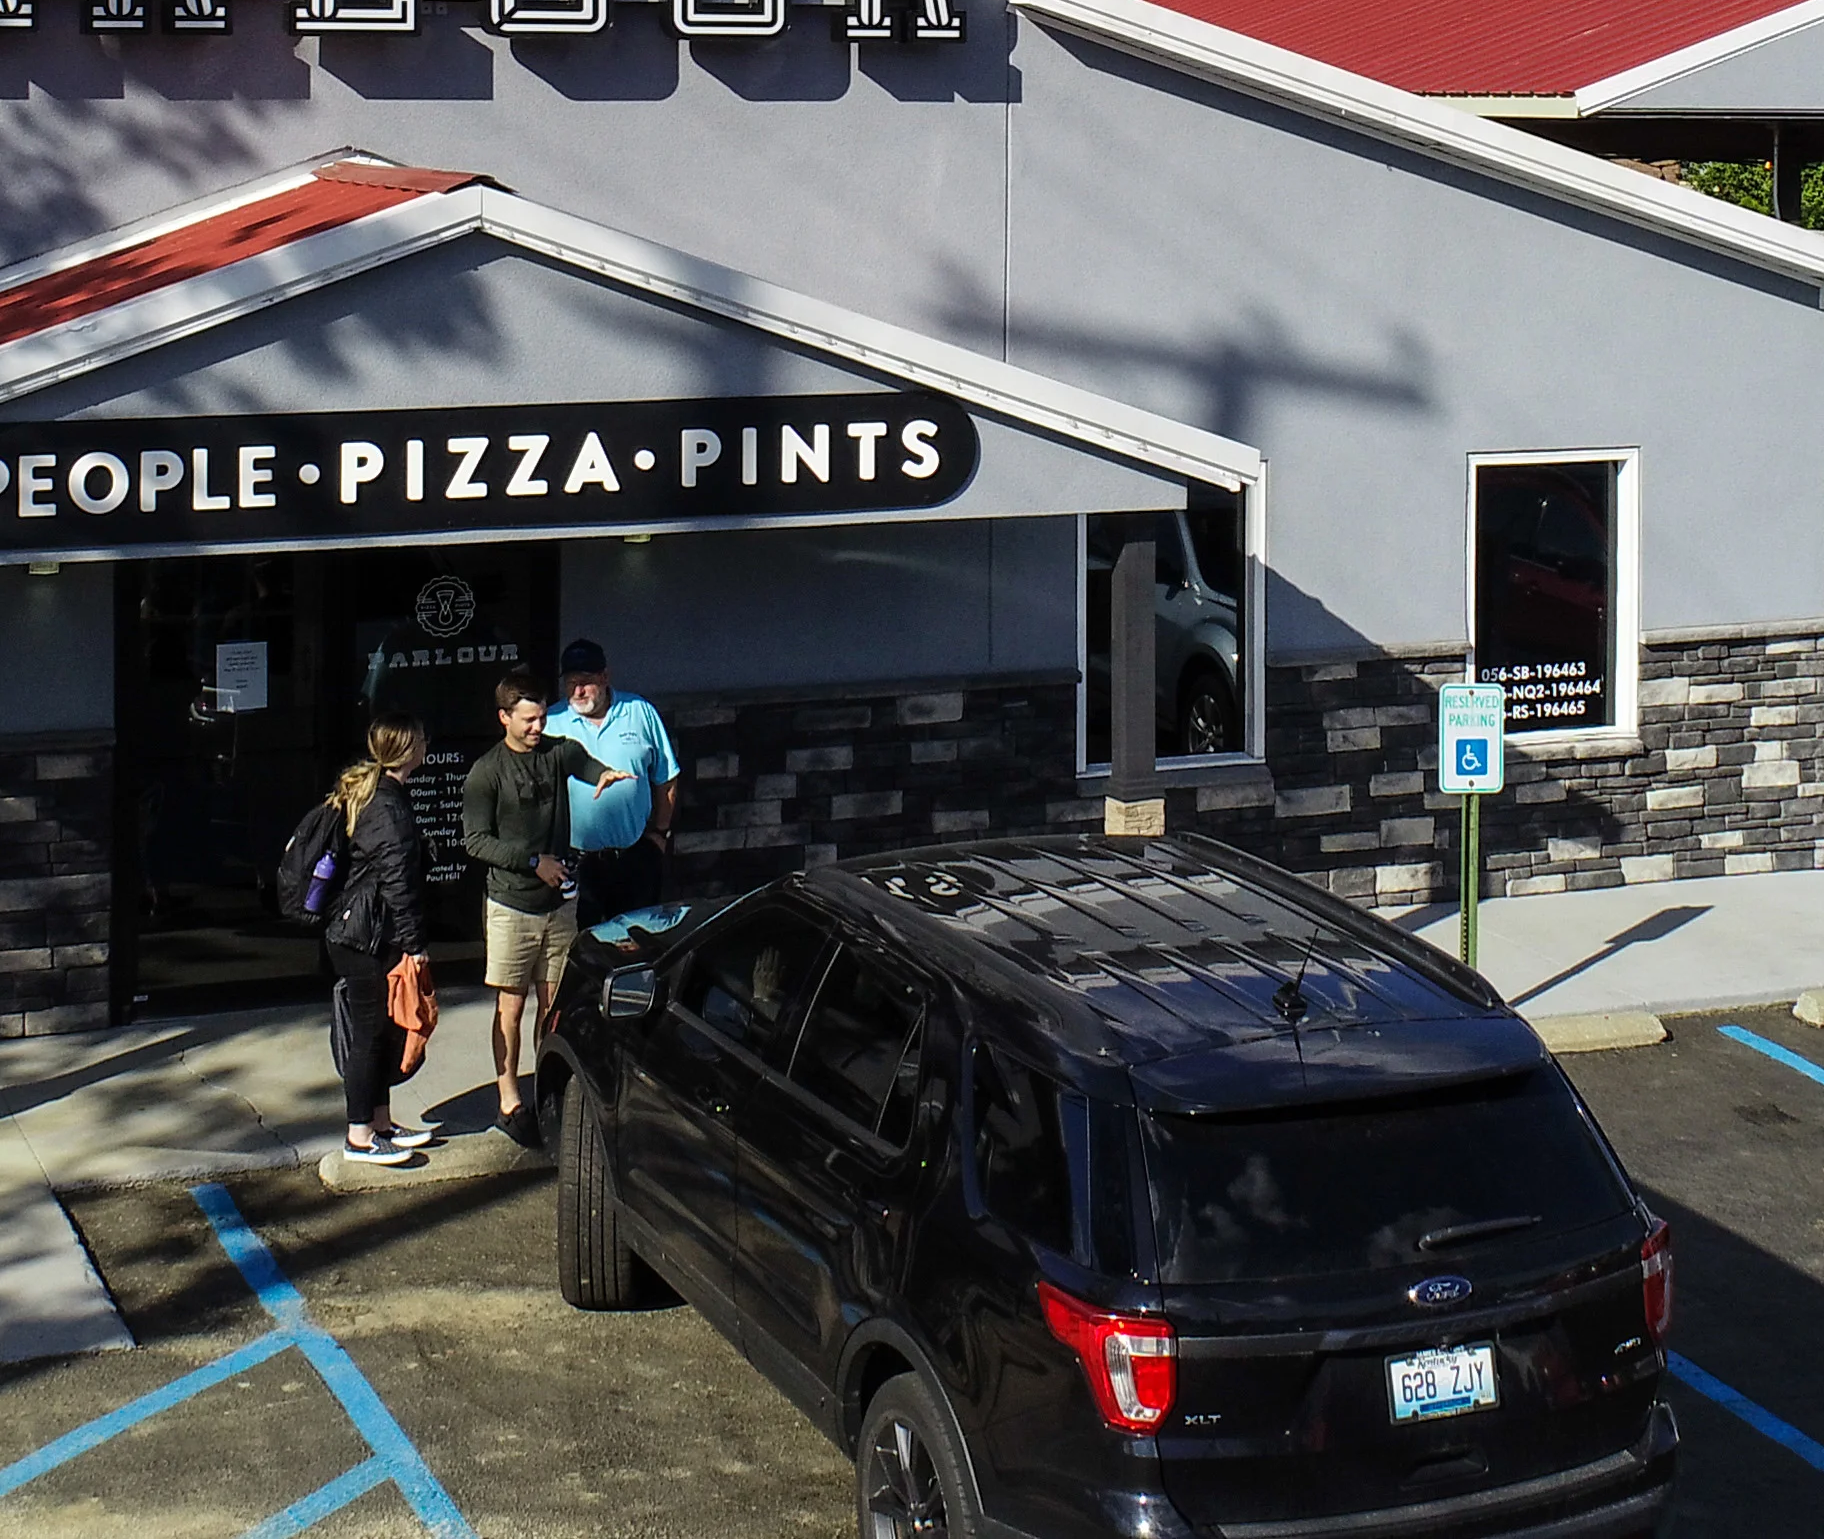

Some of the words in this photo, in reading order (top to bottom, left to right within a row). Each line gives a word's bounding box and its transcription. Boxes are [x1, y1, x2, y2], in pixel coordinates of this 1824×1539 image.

[339, 432, 622, 505] PIZZA
[680, 418, 944, 489] PINTS
[368, 644, 518, 670] PARLOUR
[1481, 661, 1586, 682] 056-SB-196463
[1445, 695, 1499, 709] RESERVED
[1503, 700, 1586, 720] -RS-196465
[1449, 713, 1496, 727] PARKING
[422, 827, 456, 837] Sunday
[456, 863, 467, 872] by
[1402, 1370, 1437, 1403] 628
[1450, 1361, 1483, 1395] ZJY
[1185, 1414, 1221, 1425] XLT
